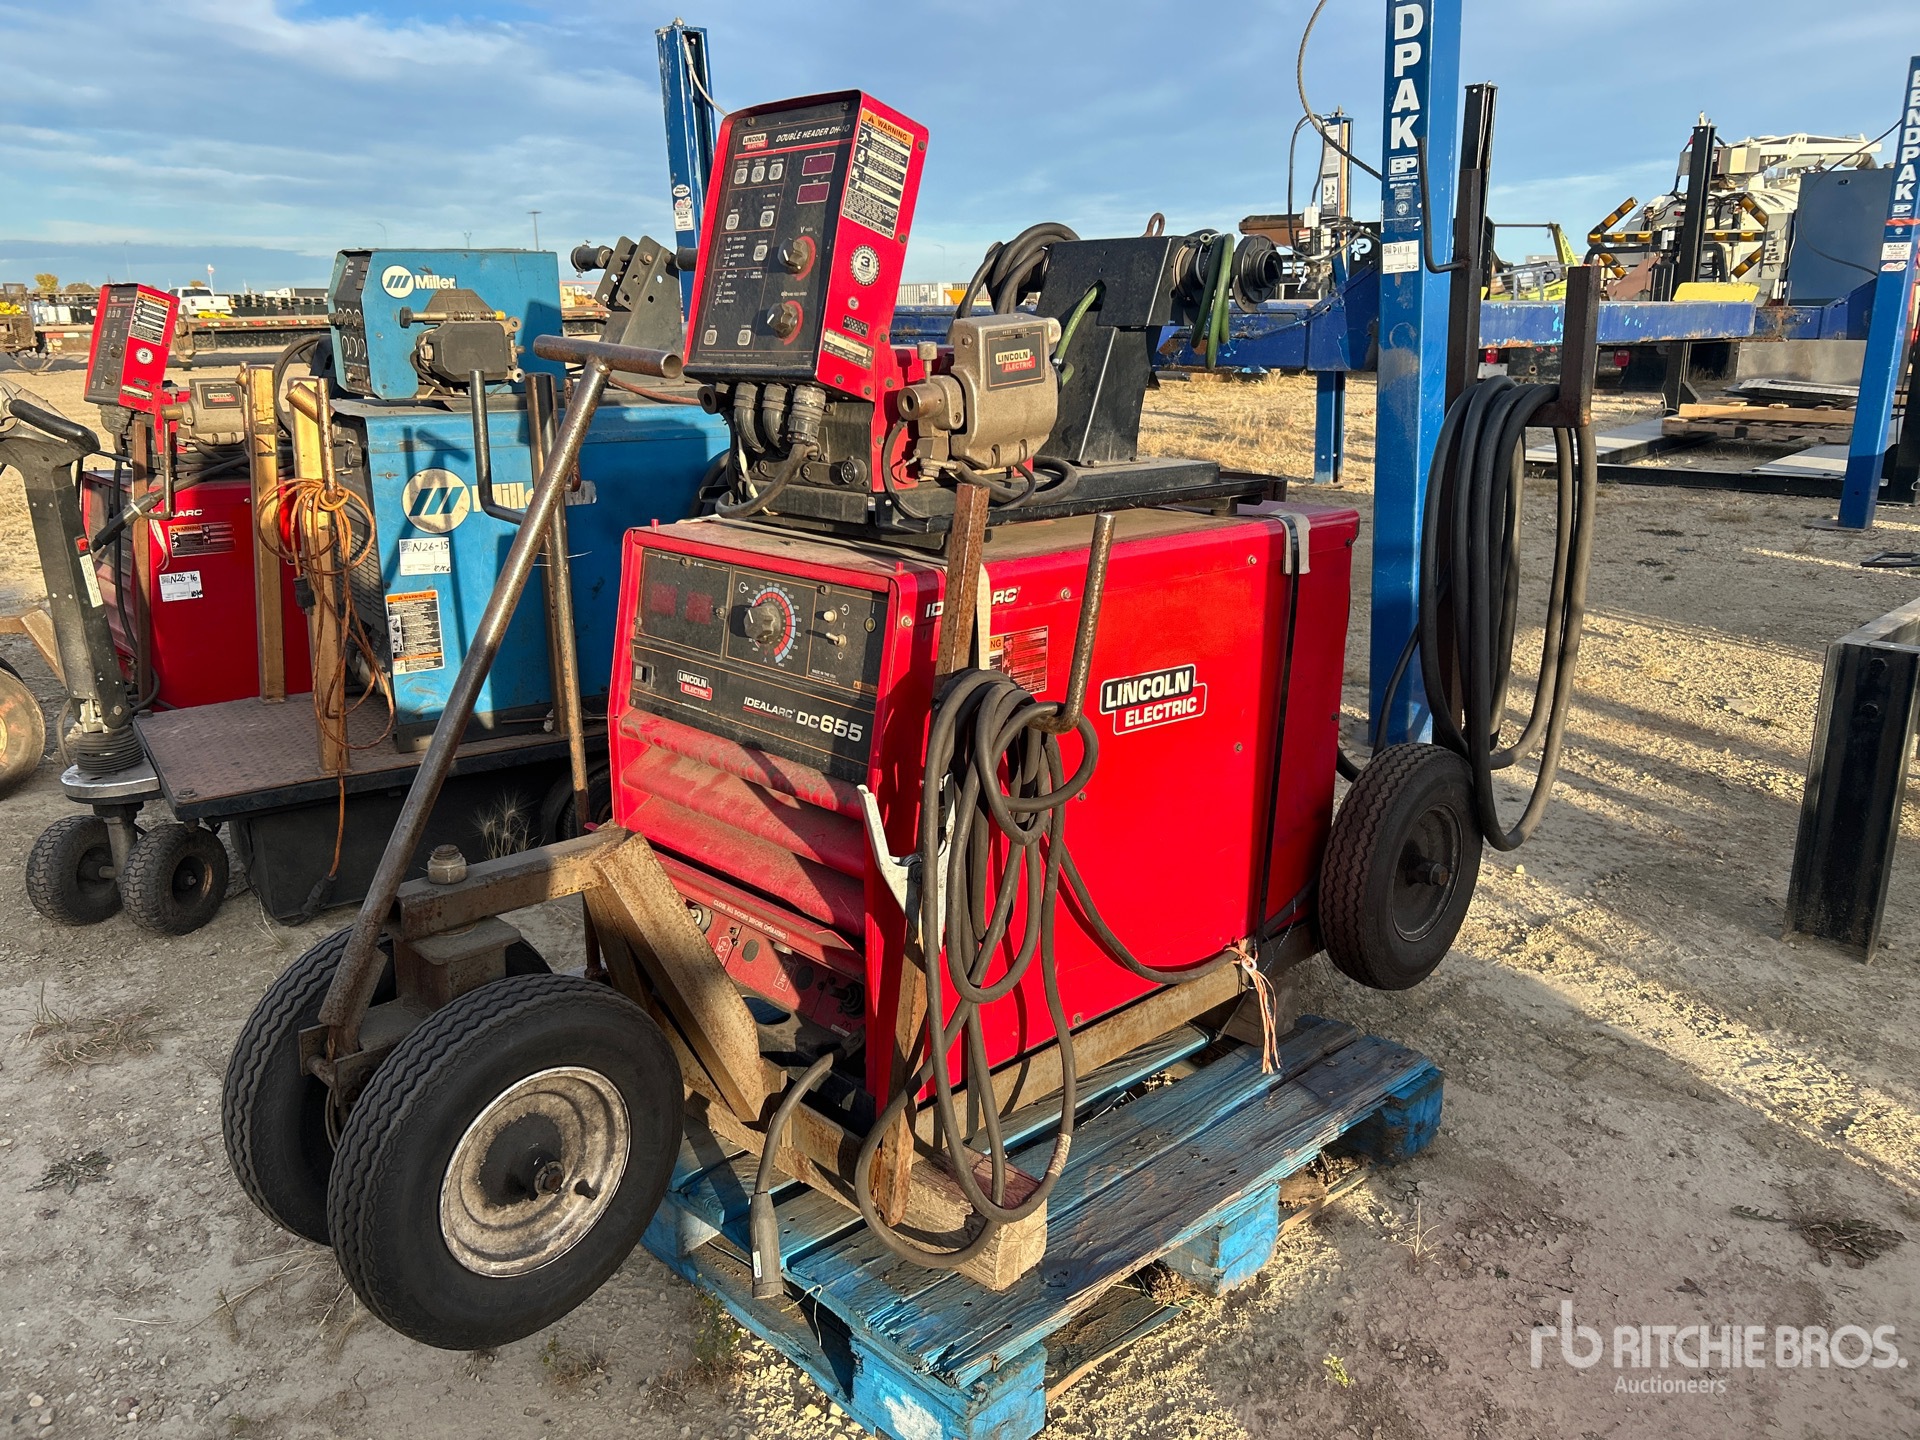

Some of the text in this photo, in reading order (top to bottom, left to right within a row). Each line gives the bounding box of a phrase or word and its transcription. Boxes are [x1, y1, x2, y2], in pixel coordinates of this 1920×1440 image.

[1390, 0, 1424, 150] DPAK
[776, 124, 850, 142] DOUBLE HEADER DH-10
[878, 118, 908, 140] WARNING
[1894, 69, 1920, 201] BENDPAK
[744, 134, 765, 143] LINCOLN
[1391, 157, 1417, 174] BP
[860, 256, 870, 268] 3
[414, 275, 456, 289] Miller
[998, 351, 1028, 362] LINCOLN
[1005, 361, 1032, 370] ELECTRIC
[472, 483, 534, 512] Mille
[412, 541, 448, 552] N26-15
[170, 573, 197, 584] N26-16
[679, 672, 706, 688] LINCOLN
[684, 685, 709, 697] ELECTRIC
[1106, 670, 1191, 708] LINCOLN
[744, 697, 863, 742] IDEALARC DC655
[1125, 697, 1197, 727] ELECTRIC
